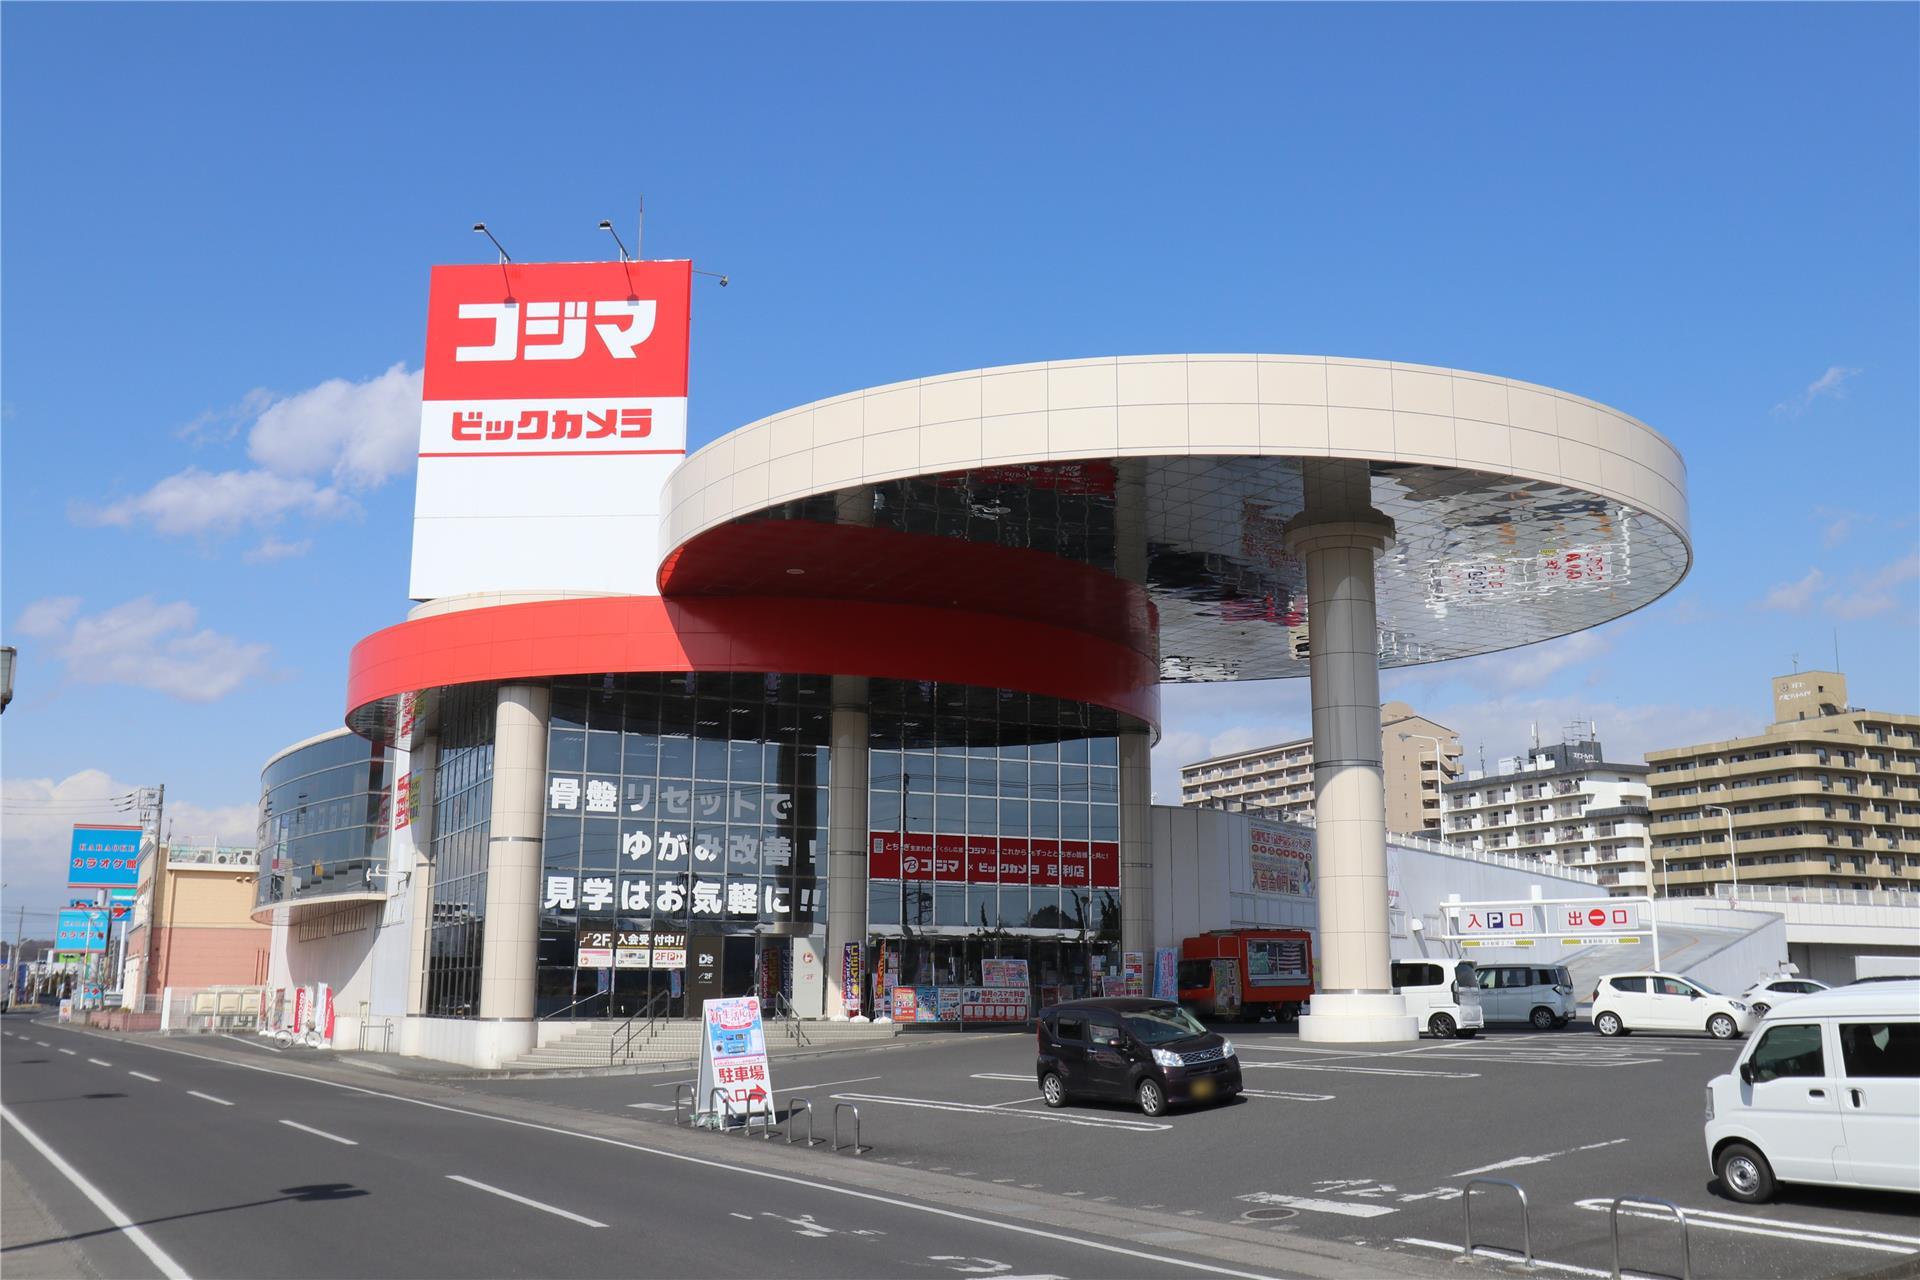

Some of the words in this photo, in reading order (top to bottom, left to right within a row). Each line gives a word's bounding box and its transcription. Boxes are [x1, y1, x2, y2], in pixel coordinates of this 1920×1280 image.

[455, 299, 657, 362] コジマ
[451, 408, 652, 441] ビックカメラ
[549, 777, 793, 820] 骨盤リセットで
[72, 858, 138, 869] カラオケ館
[920, 859, 960, 873] コジマ
[978, 862, 1040, 875] ビックカメラ
[1046, 864, 1085, 878] 足利店
[592, 932, 611, 947] 2F
[655, 952, 667, 961] 2F
[718, 1065, 765, 1083] 駐車場
